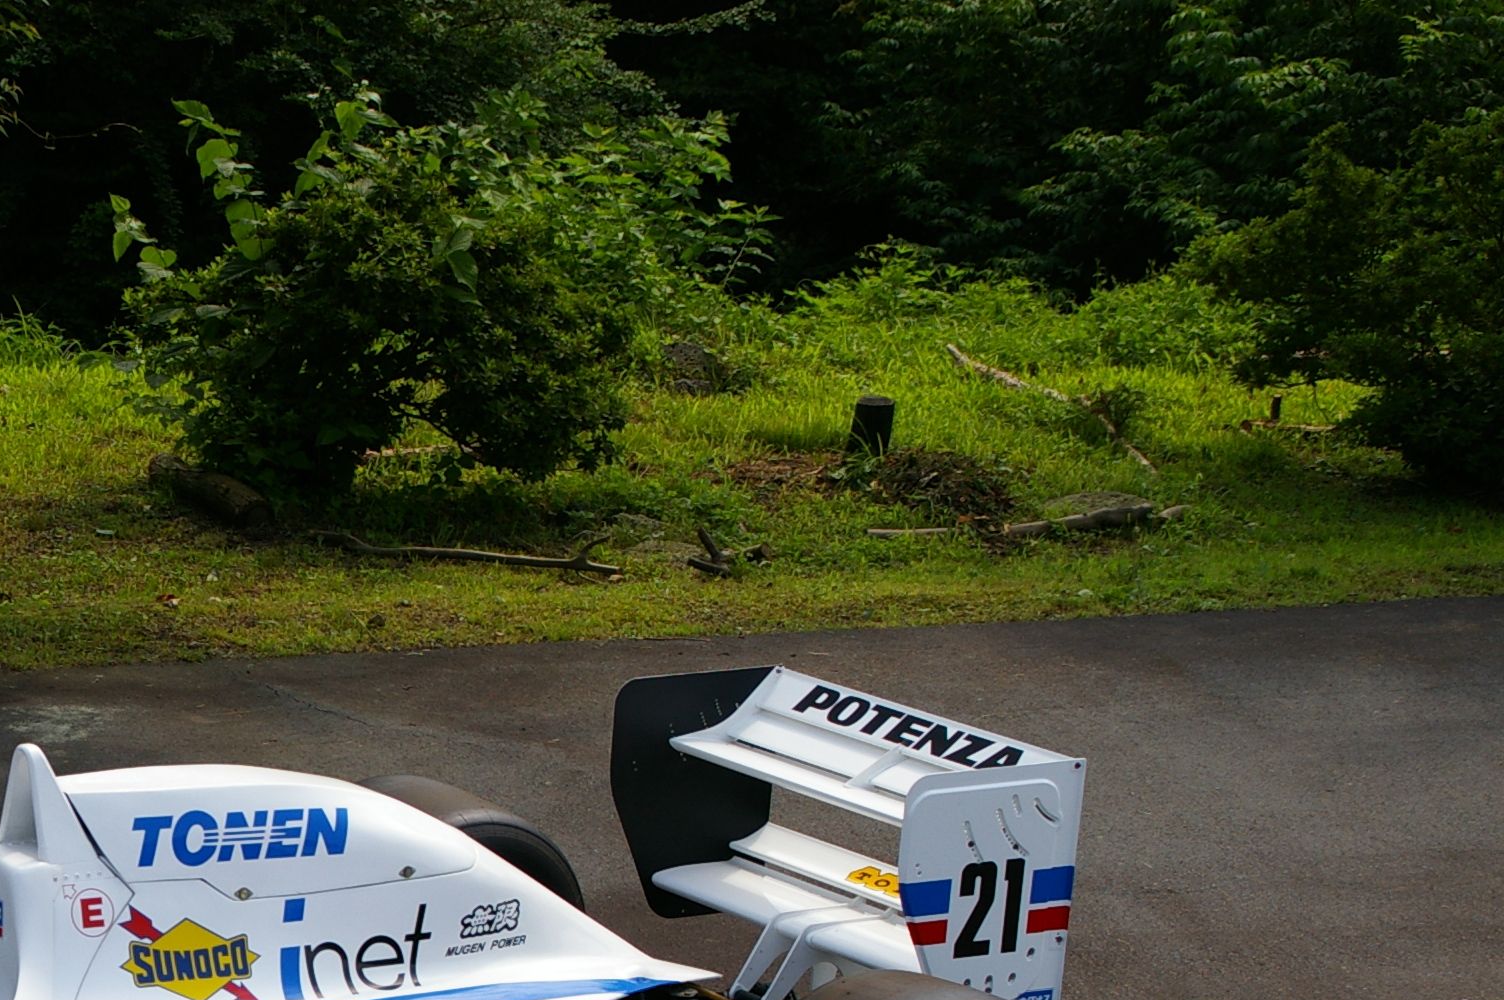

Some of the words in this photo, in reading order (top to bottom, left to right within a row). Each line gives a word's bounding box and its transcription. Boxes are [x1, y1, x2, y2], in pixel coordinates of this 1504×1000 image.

[792, 684, 1025, 770] POTENZA
[132, 807, 349, 868] TONEN
[79, 896, 105, 929] E
[953, 857, 1026, 959] 21
[131, 937, 250, 985] SUNOCO
[445, 942, 486, 957] MUGEN
[490, 935, 527, 950] POWER
